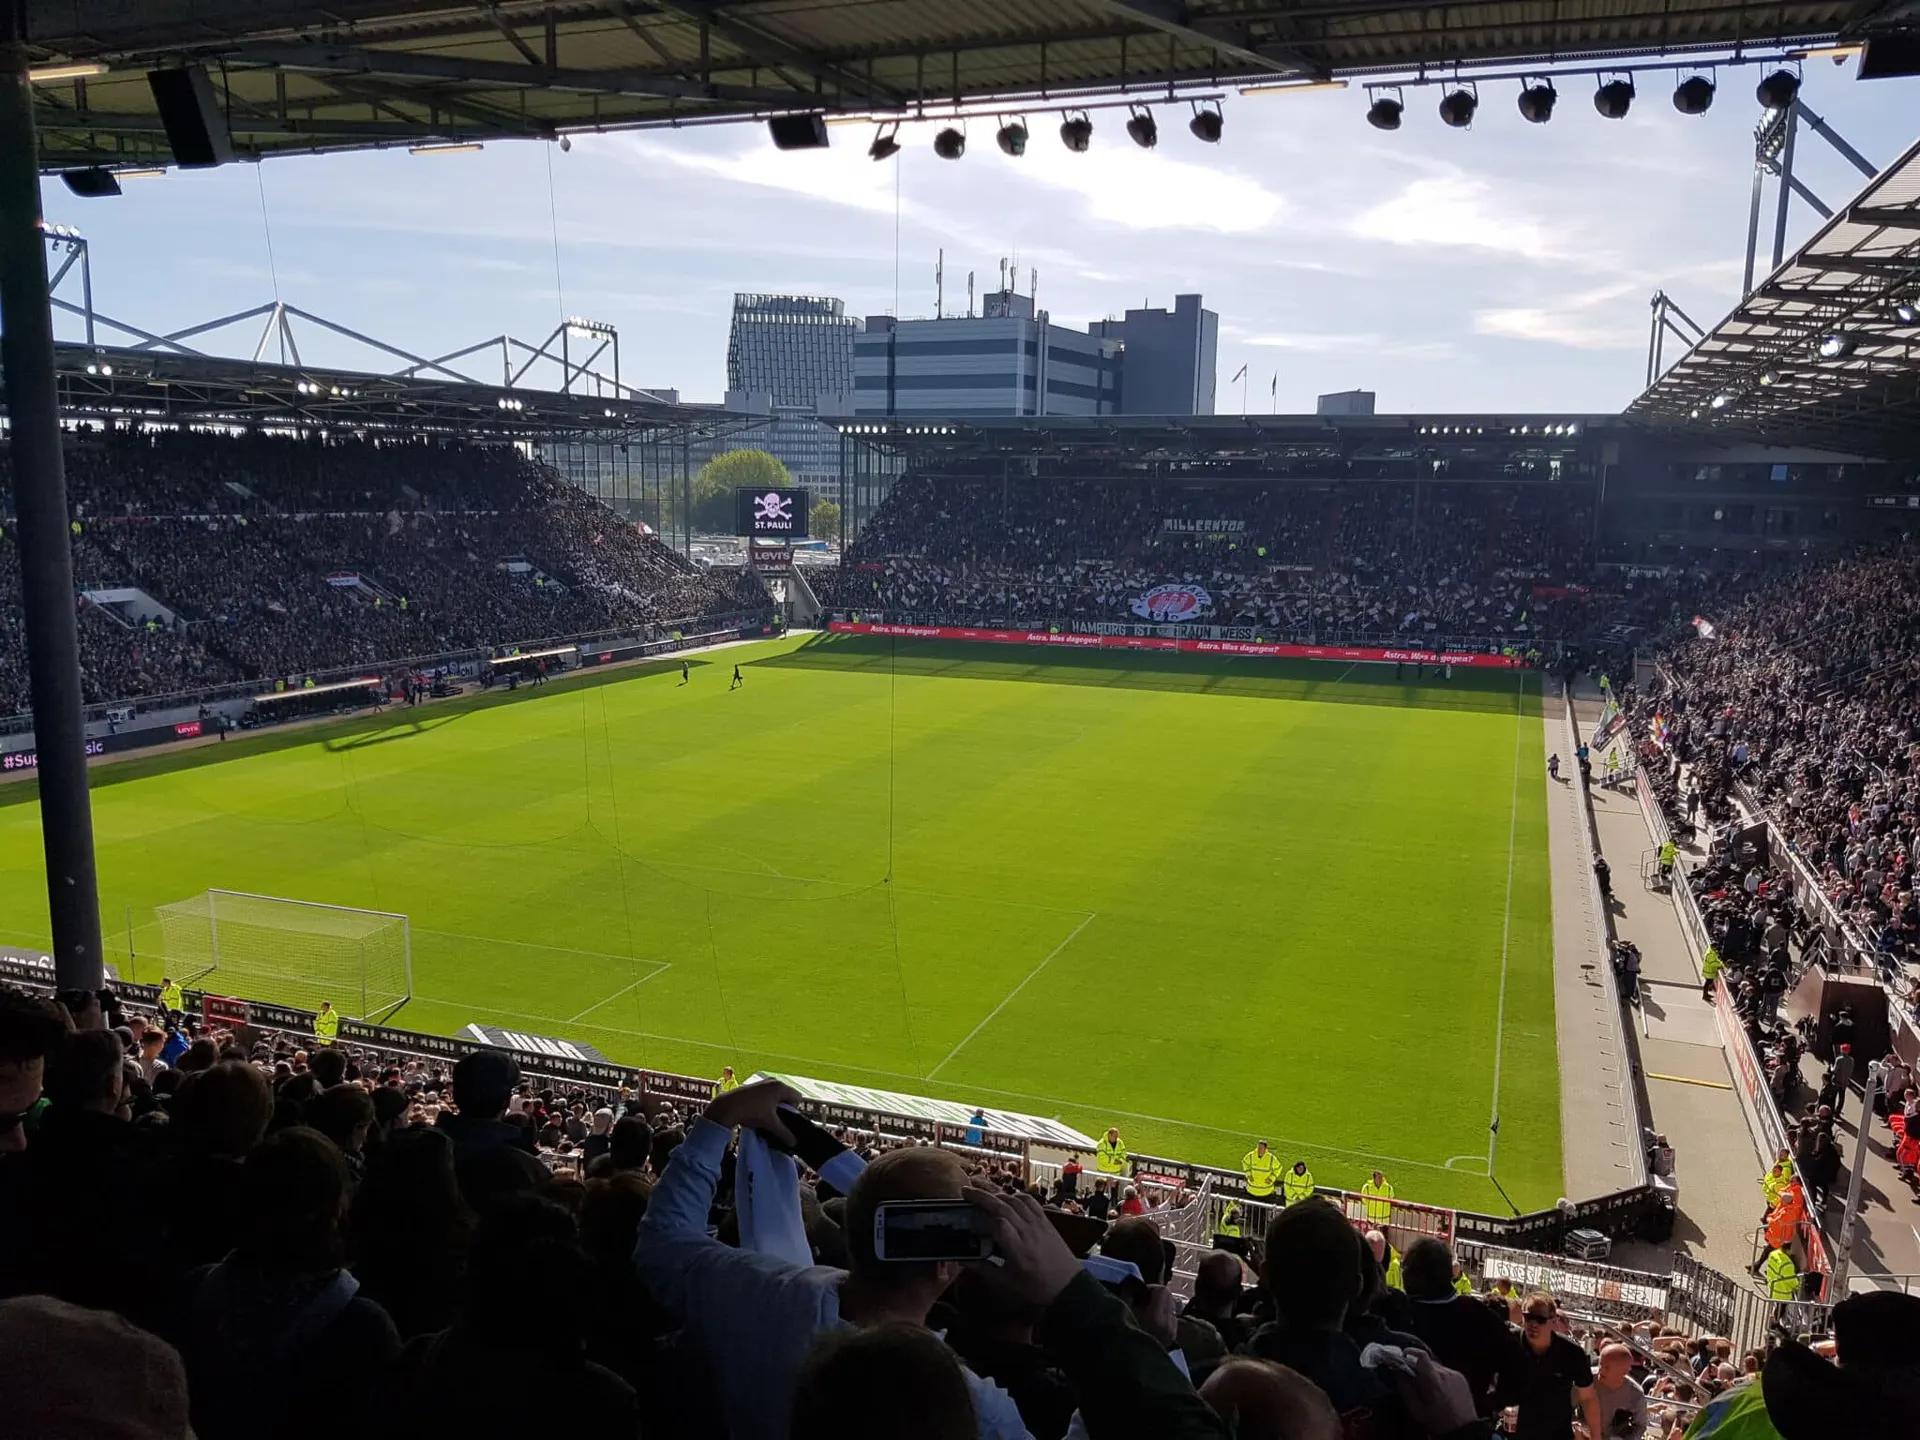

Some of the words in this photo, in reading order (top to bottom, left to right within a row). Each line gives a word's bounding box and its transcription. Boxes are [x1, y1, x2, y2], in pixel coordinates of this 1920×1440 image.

[754, 521, 766, 529] ST.
[767, 521, 792, 529] PAULI
[1163, 519, 1246, 532] MILLERNTOR
[1071, 620, 1127, 636] HAMBURG
[1430, 653, 1474, 664] dgegen?
